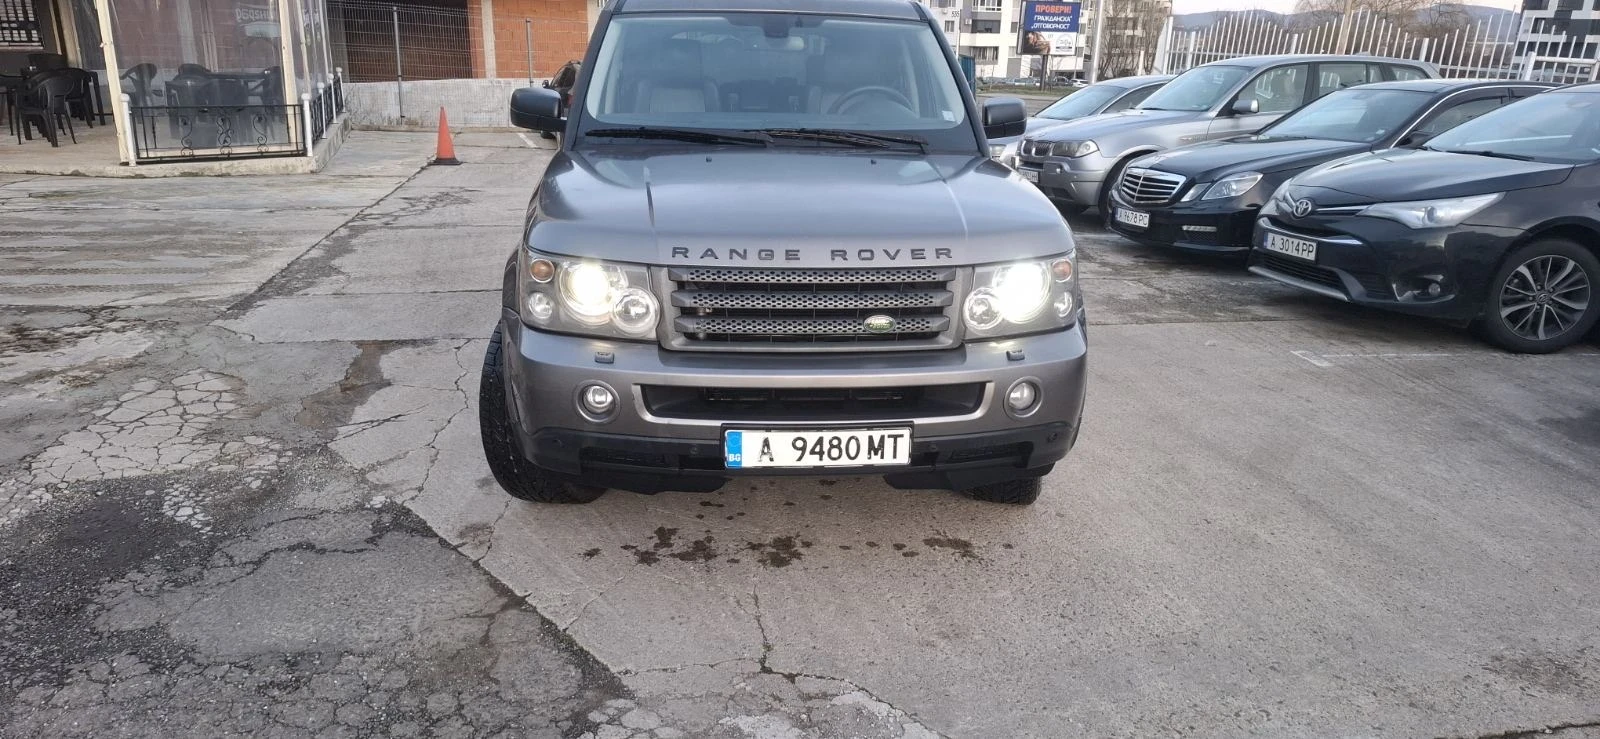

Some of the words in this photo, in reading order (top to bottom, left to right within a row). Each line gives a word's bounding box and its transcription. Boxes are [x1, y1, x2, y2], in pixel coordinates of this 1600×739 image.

[1035, 4, 1072, 14] ПРОВЕРИ!
[1270, 234, 1276, 249] A
[671, 246, 801, 261] RANGE
[830, 247, 953, 261] ROVER
[728, 453, 741, 462] BG
[757, 436, 774, 462] A
